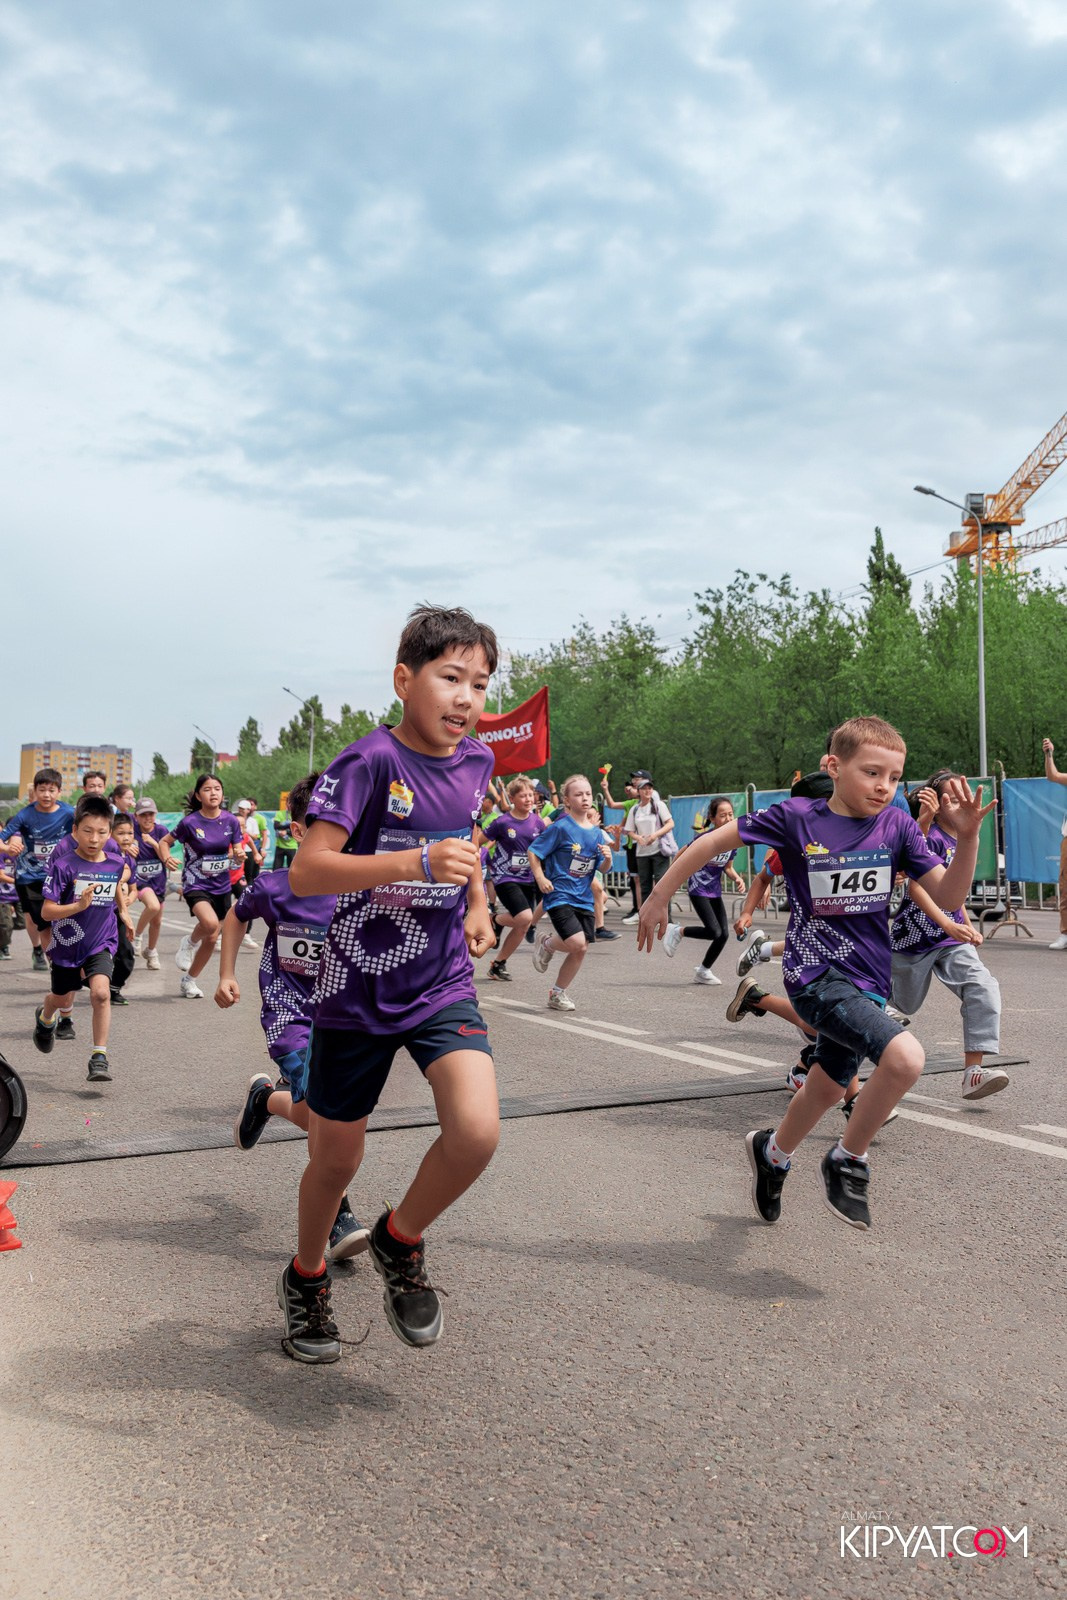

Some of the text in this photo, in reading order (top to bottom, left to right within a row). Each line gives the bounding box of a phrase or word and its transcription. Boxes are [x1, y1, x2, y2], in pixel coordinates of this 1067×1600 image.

[391, 798, 400, 806] BI
[392, 805, 409, 815] RUN
[41, 846, 53, 854] 07
[209, 861, 225, 870] 163
[830, 870, 878, 894] 146
[88, 882, 112, 896] 04
[374, 884, 428, 897] БАЛАЛАР
[411, 898, 433, 906] 600
[815, 894, 888, 906] БАЛАЛАР ЖАРЫСЫ
[844, 904, 861, 912] 600
[292, 940, 323, 961] 03
[281, 957, 314, 969] БАЛАЛАР
